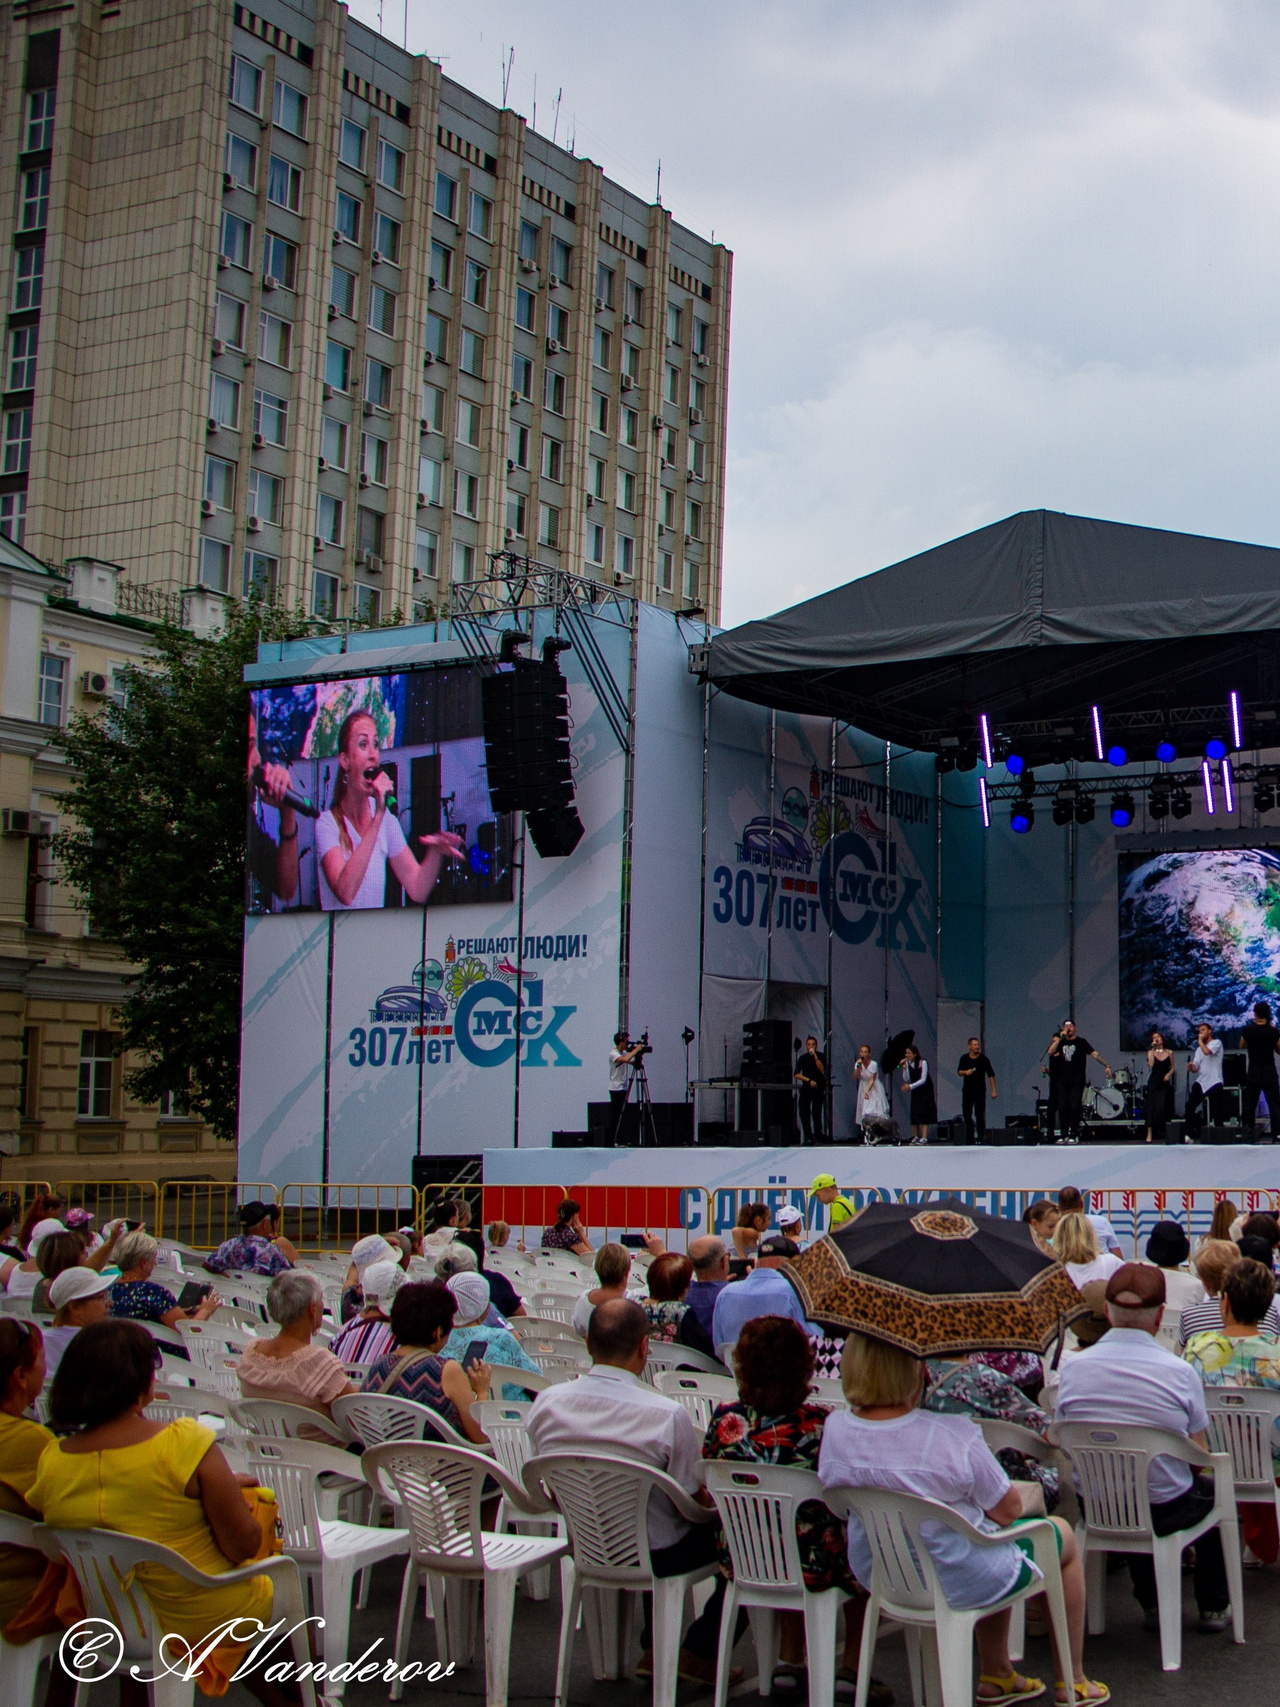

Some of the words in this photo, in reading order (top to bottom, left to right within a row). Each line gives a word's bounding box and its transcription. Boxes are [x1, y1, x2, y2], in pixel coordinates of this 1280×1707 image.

[820, 769, 874, 803] РЕШАЮТ
[875, 785, 929, 825] ЛЮДИ!
[713, 865, 777, 929] 307
[777, 895, 820, 932] лет
[456, 936, 518, 955] РЕШАЮТ
[521, 934, 588, 961] ЛЮДИ!
[348, 1026, 408, 1067] 307
[406, 1038, 456, 1064] лет
